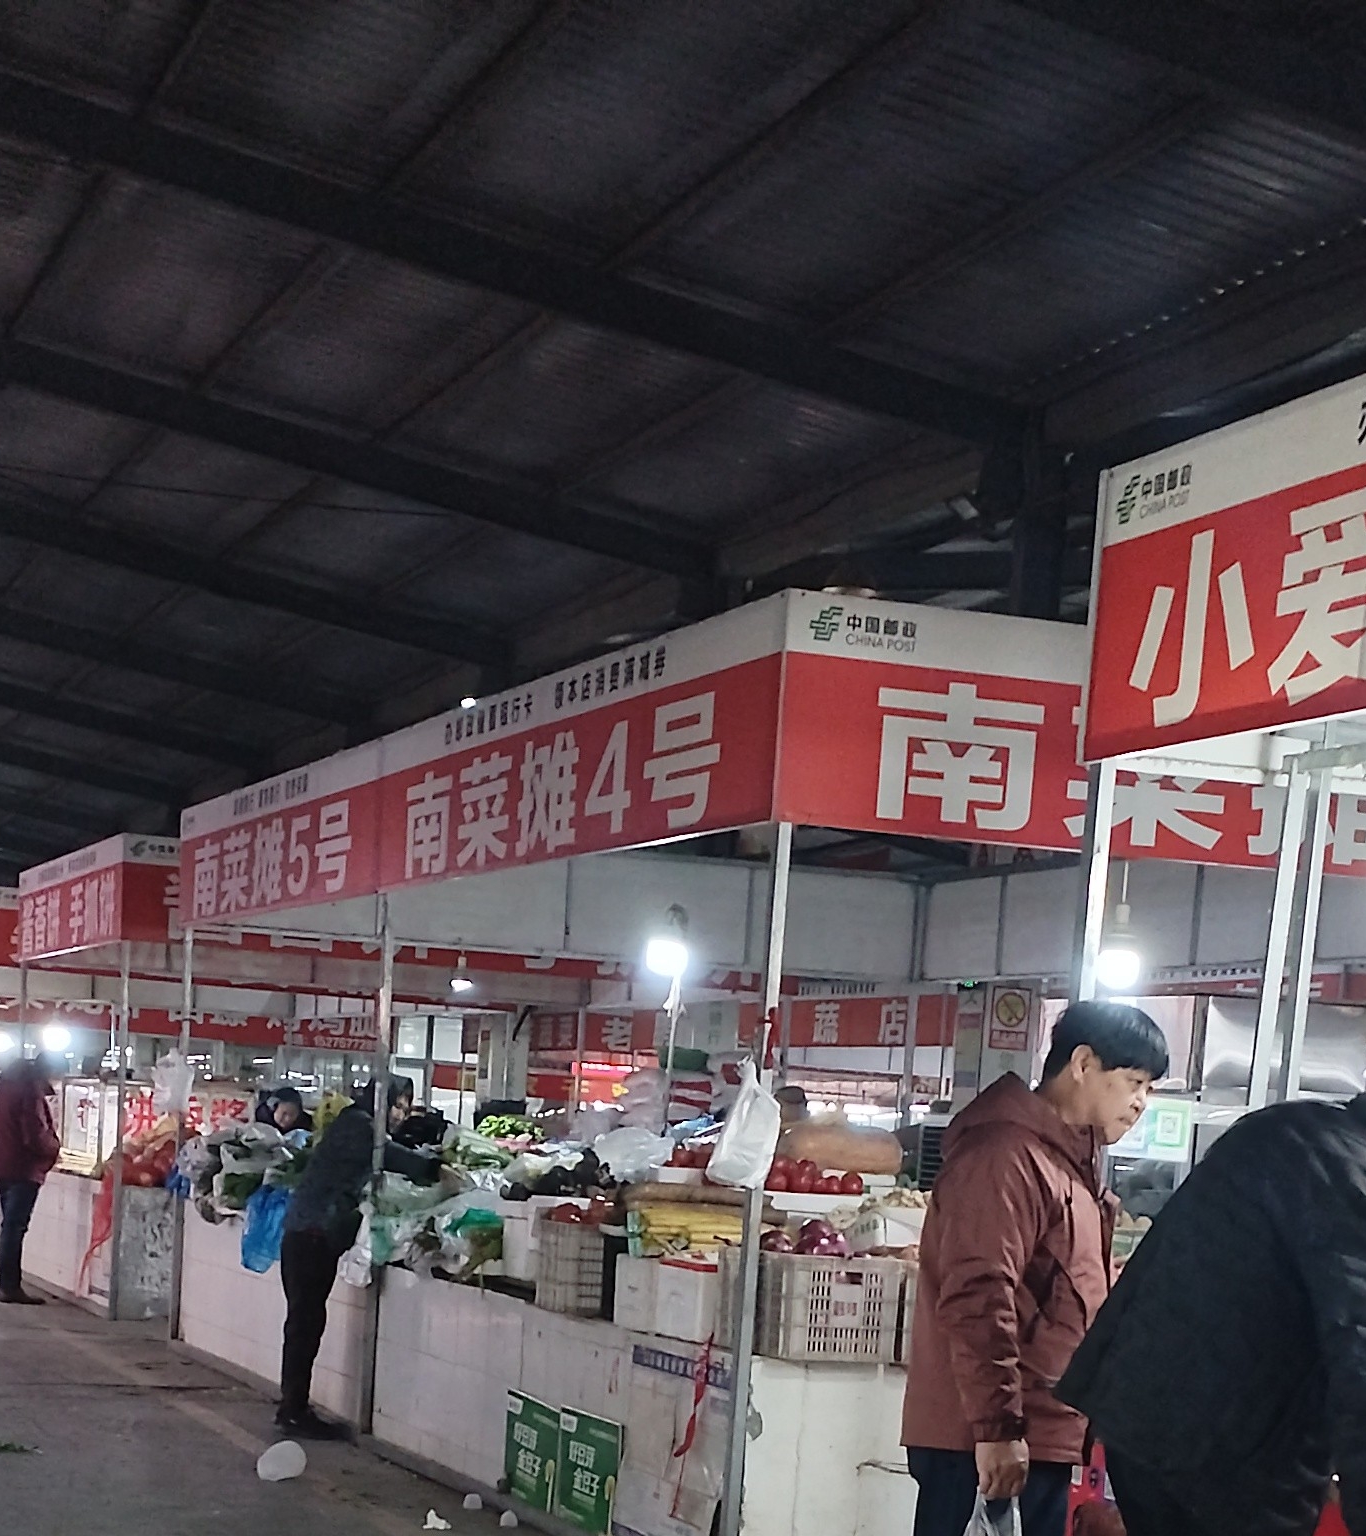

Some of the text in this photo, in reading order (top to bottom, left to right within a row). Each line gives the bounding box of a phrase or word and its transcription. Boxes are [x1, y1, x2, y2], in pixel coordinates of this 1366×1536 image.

[845, 633, 916, 653] CHINA POST
[846, 613, 917, 639] 中国邮政
[404, 691, 722, 880] 南菜摊4号
[193, 799, 353, 919] 南菜摊5号
